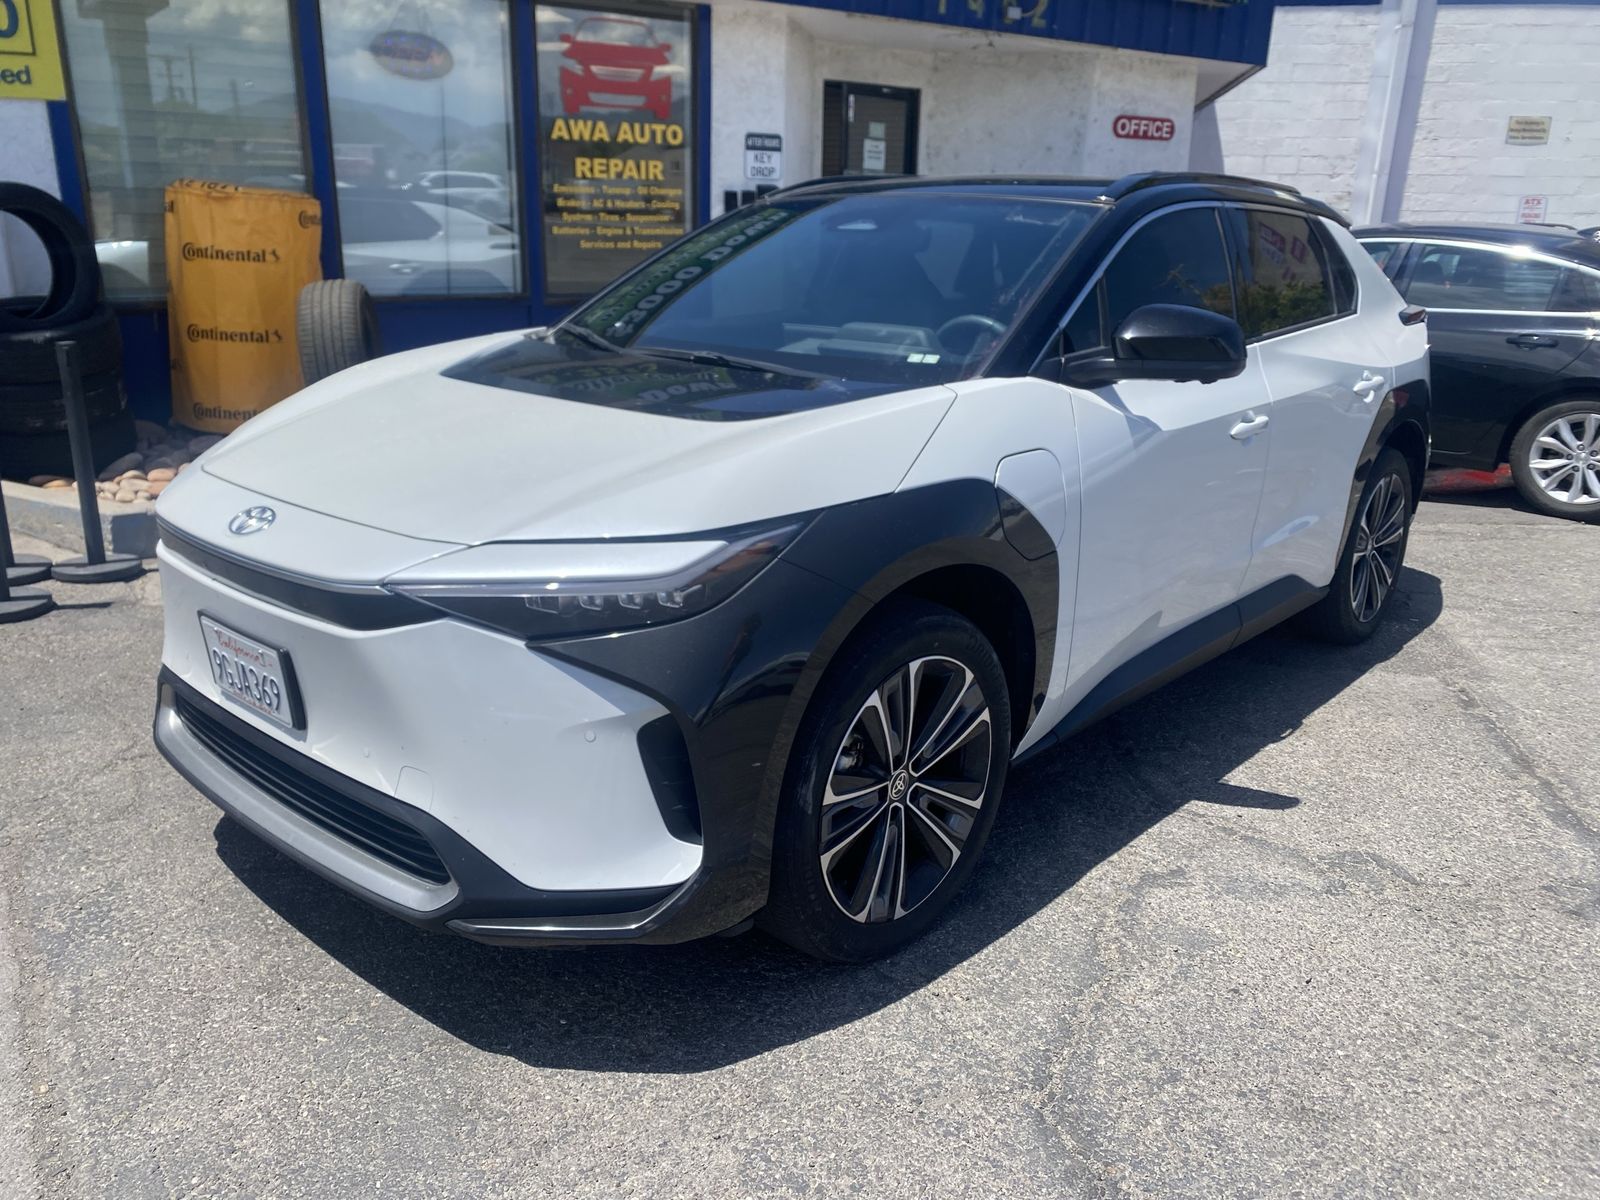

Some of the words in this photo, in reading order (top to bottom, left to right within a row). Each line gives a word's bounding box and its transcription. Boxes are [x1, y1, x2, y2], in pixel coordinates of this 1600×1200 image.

[551, 117, 610, 142] AWA
[616, 121, 683, 146] AUTO
[1117, 118, 1171, 138] OFFICE
[754, 152, 773, 164] KEY
[575, 157, 665, 180] REPAIR
[751, 166, 776, 177] DROP
[596, 226, 623, 236] Engine
[182, 242, 266, 263] Continental
[617, 240, 631, 249] and
[187, 323, 269, 343] Continental
[211, 647, 281, 713] 9GJA369
